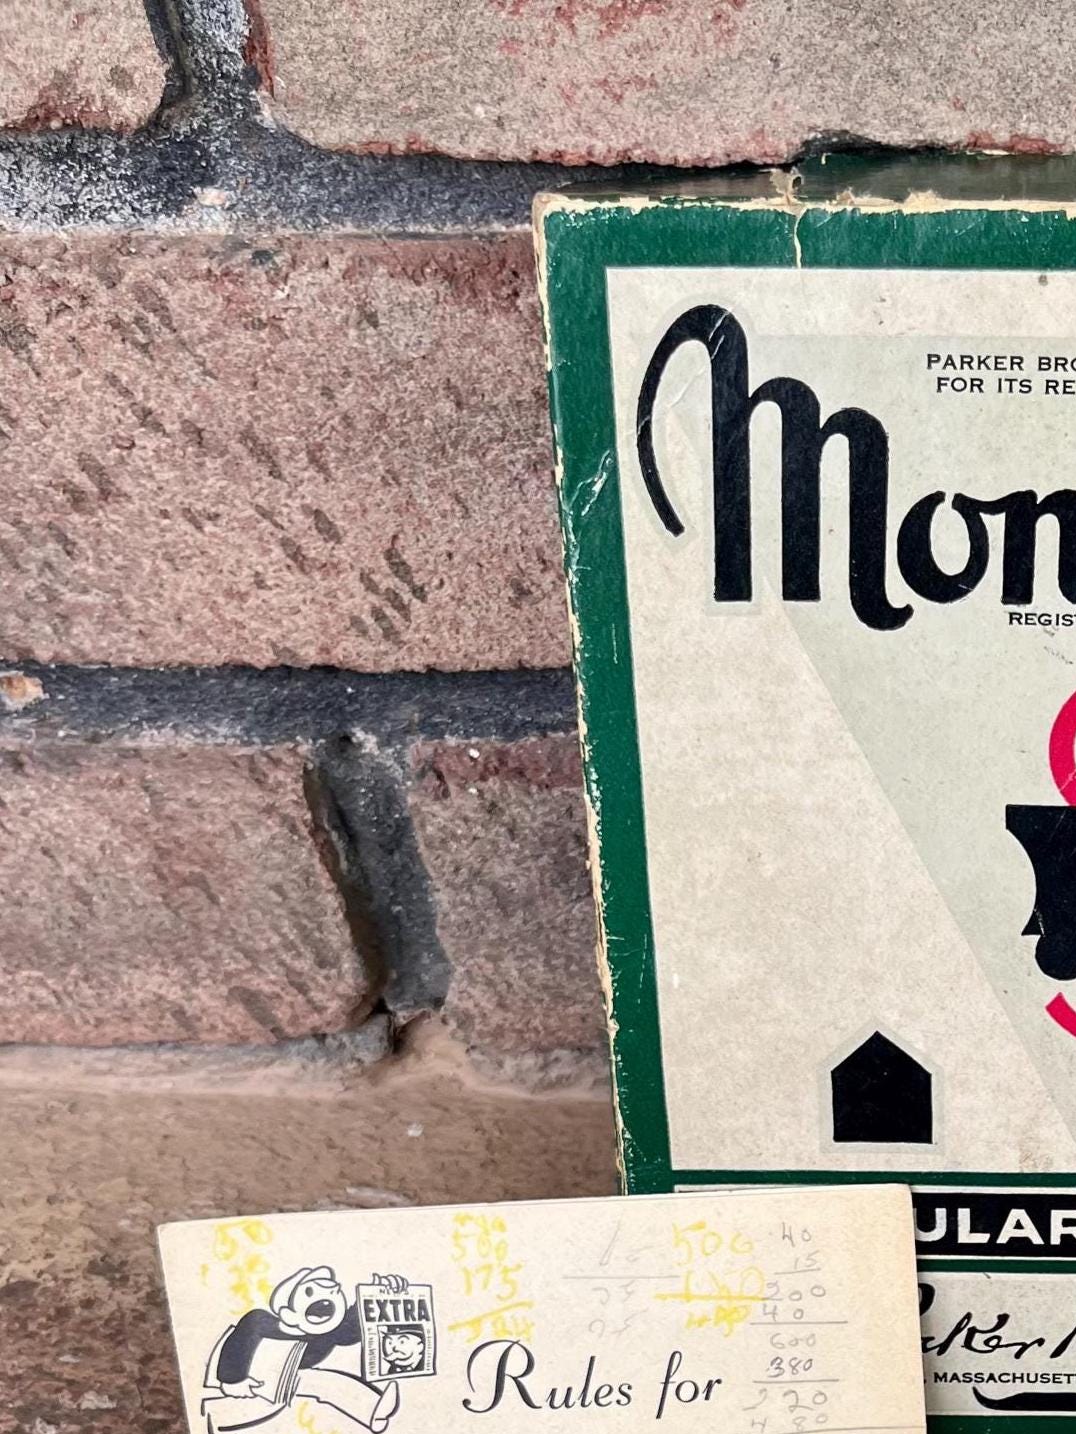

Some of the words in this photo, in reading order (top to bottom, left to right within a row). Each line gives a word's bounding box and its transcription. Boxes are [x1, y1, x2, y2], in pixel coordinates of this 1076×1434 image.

[926, 352, 1026, 372] PARKER
[935, 376, 985, 394] FOR
[996, 378, 1035, 395] ITS
[781, 1221, 812, 1247] 40
[363, 1298, 430, 1323] EXTRA
[461, 1338, 633, 1415] Rules
[655, 1350, 722, 1420] for
